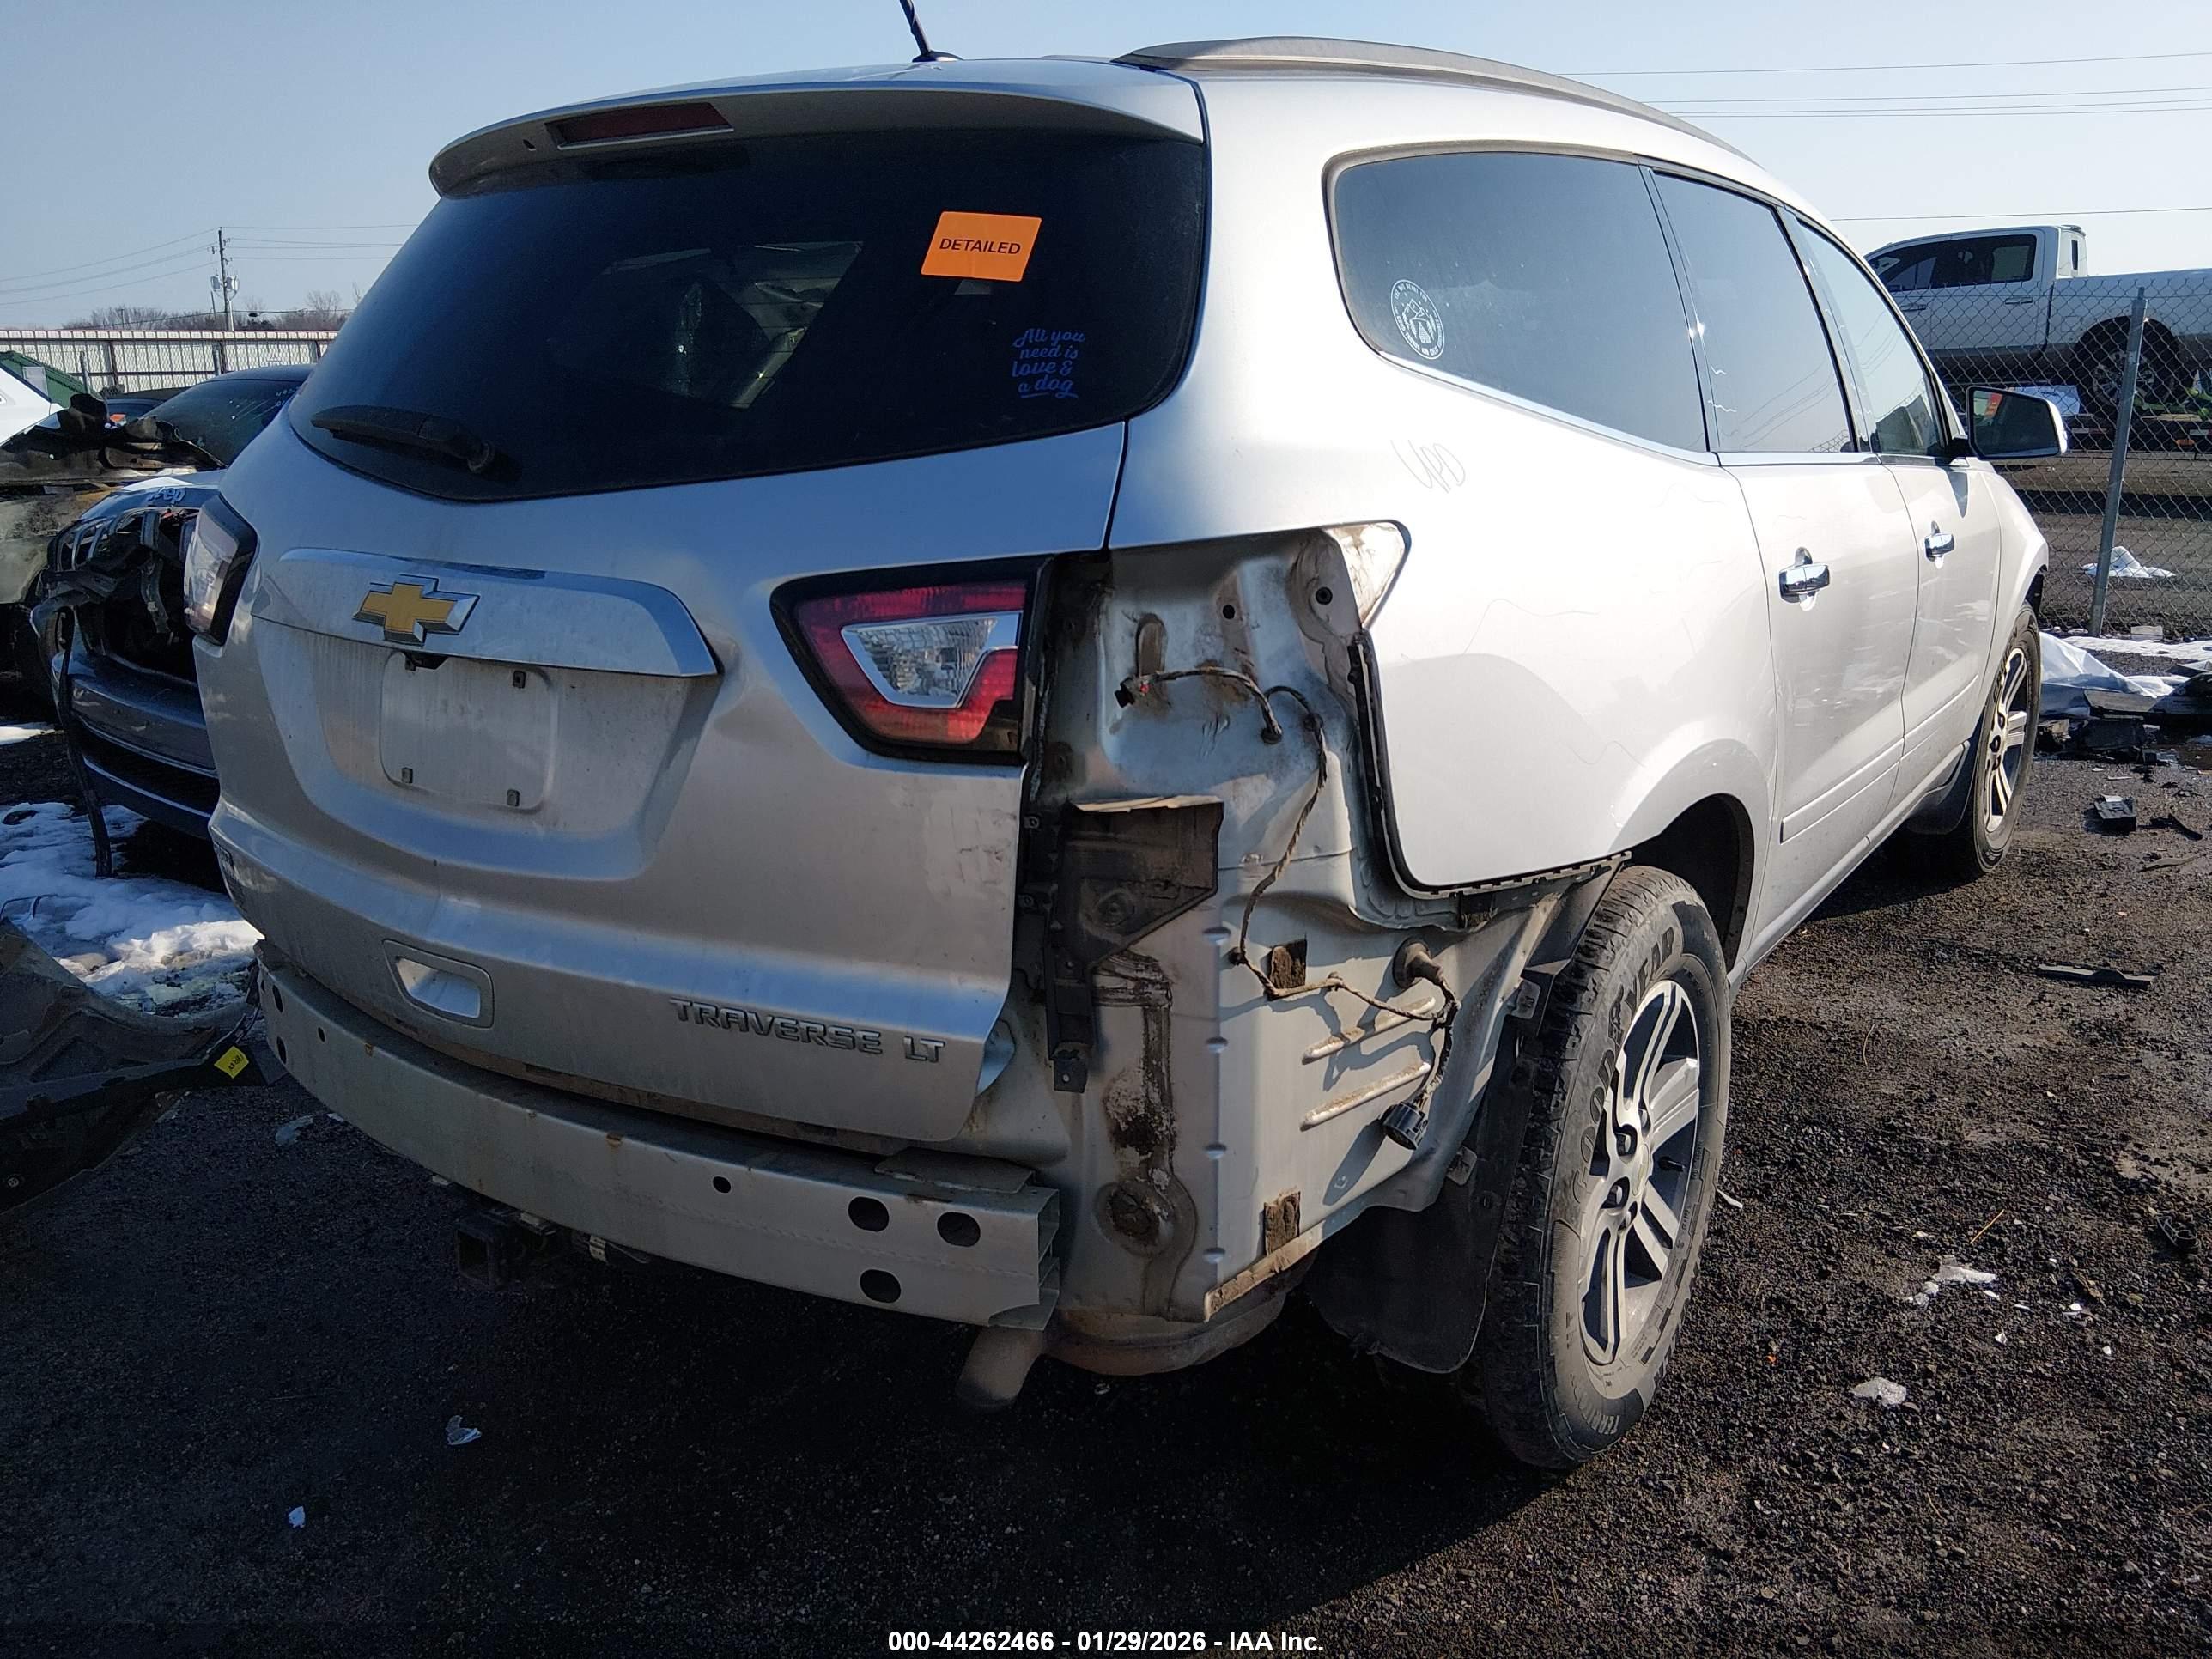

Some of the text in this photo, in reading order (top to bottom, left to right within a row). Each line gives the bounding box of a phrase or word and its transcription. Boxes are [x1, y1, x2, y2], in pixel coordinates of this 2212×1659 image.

[939, 238, 1021, 255] DETAILED
[1012, 328, 1086, 348] All you
[1019, 343, 1079, 359] need is
[1012, 360, 1073, 378] love &
[1018, 374, 1079, 399] a dog
[669, 996, 945, 1063] TRAVERSE LT
